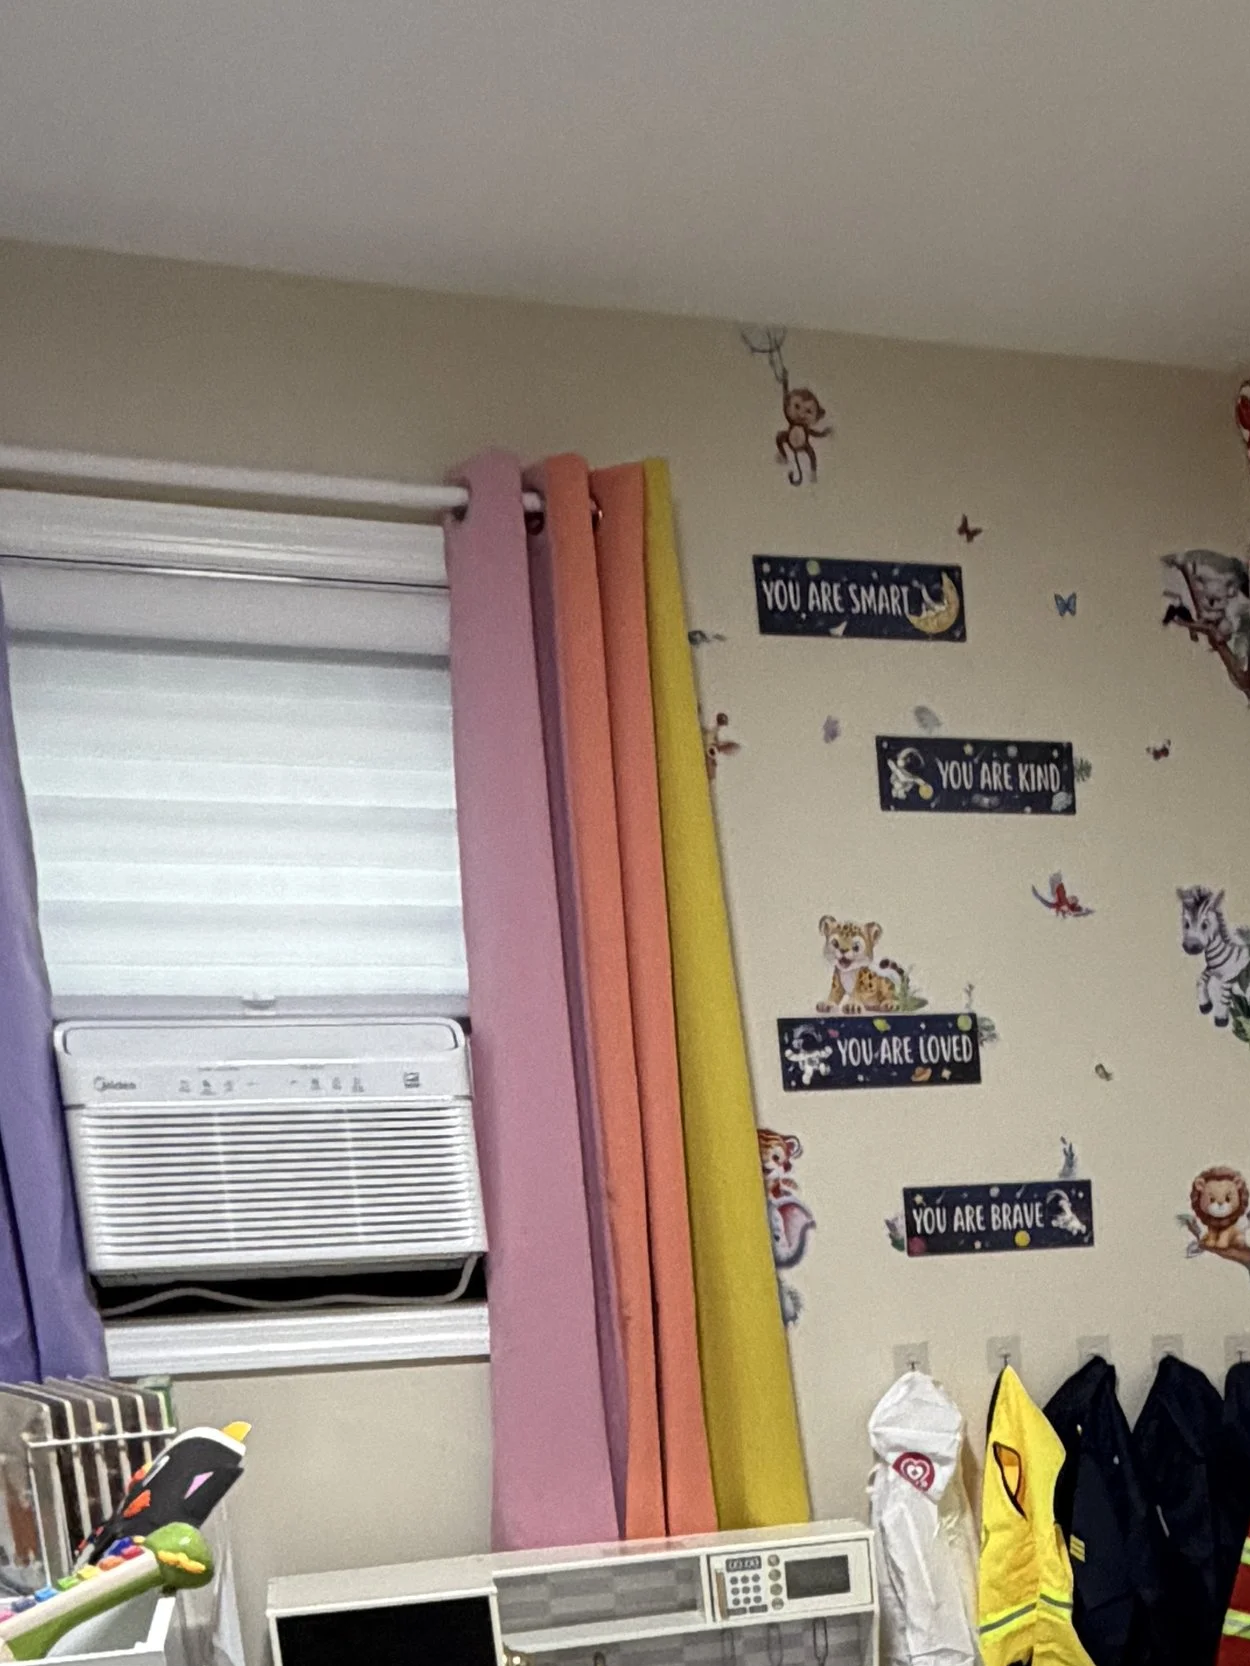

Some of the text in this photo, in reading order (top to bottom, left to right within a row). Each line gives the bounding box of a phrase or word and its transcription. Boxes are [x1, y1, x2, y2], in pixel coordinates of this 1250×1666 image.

[762, 579, 911, 616] YOU ARE SMART
[936, 757, 1061, 792] YOU ARE KIND
[837, 1034, 973, 1067] YOU ARE LOVED
[912, 1202, 1045, 1235] YOU ARE BRAVE
